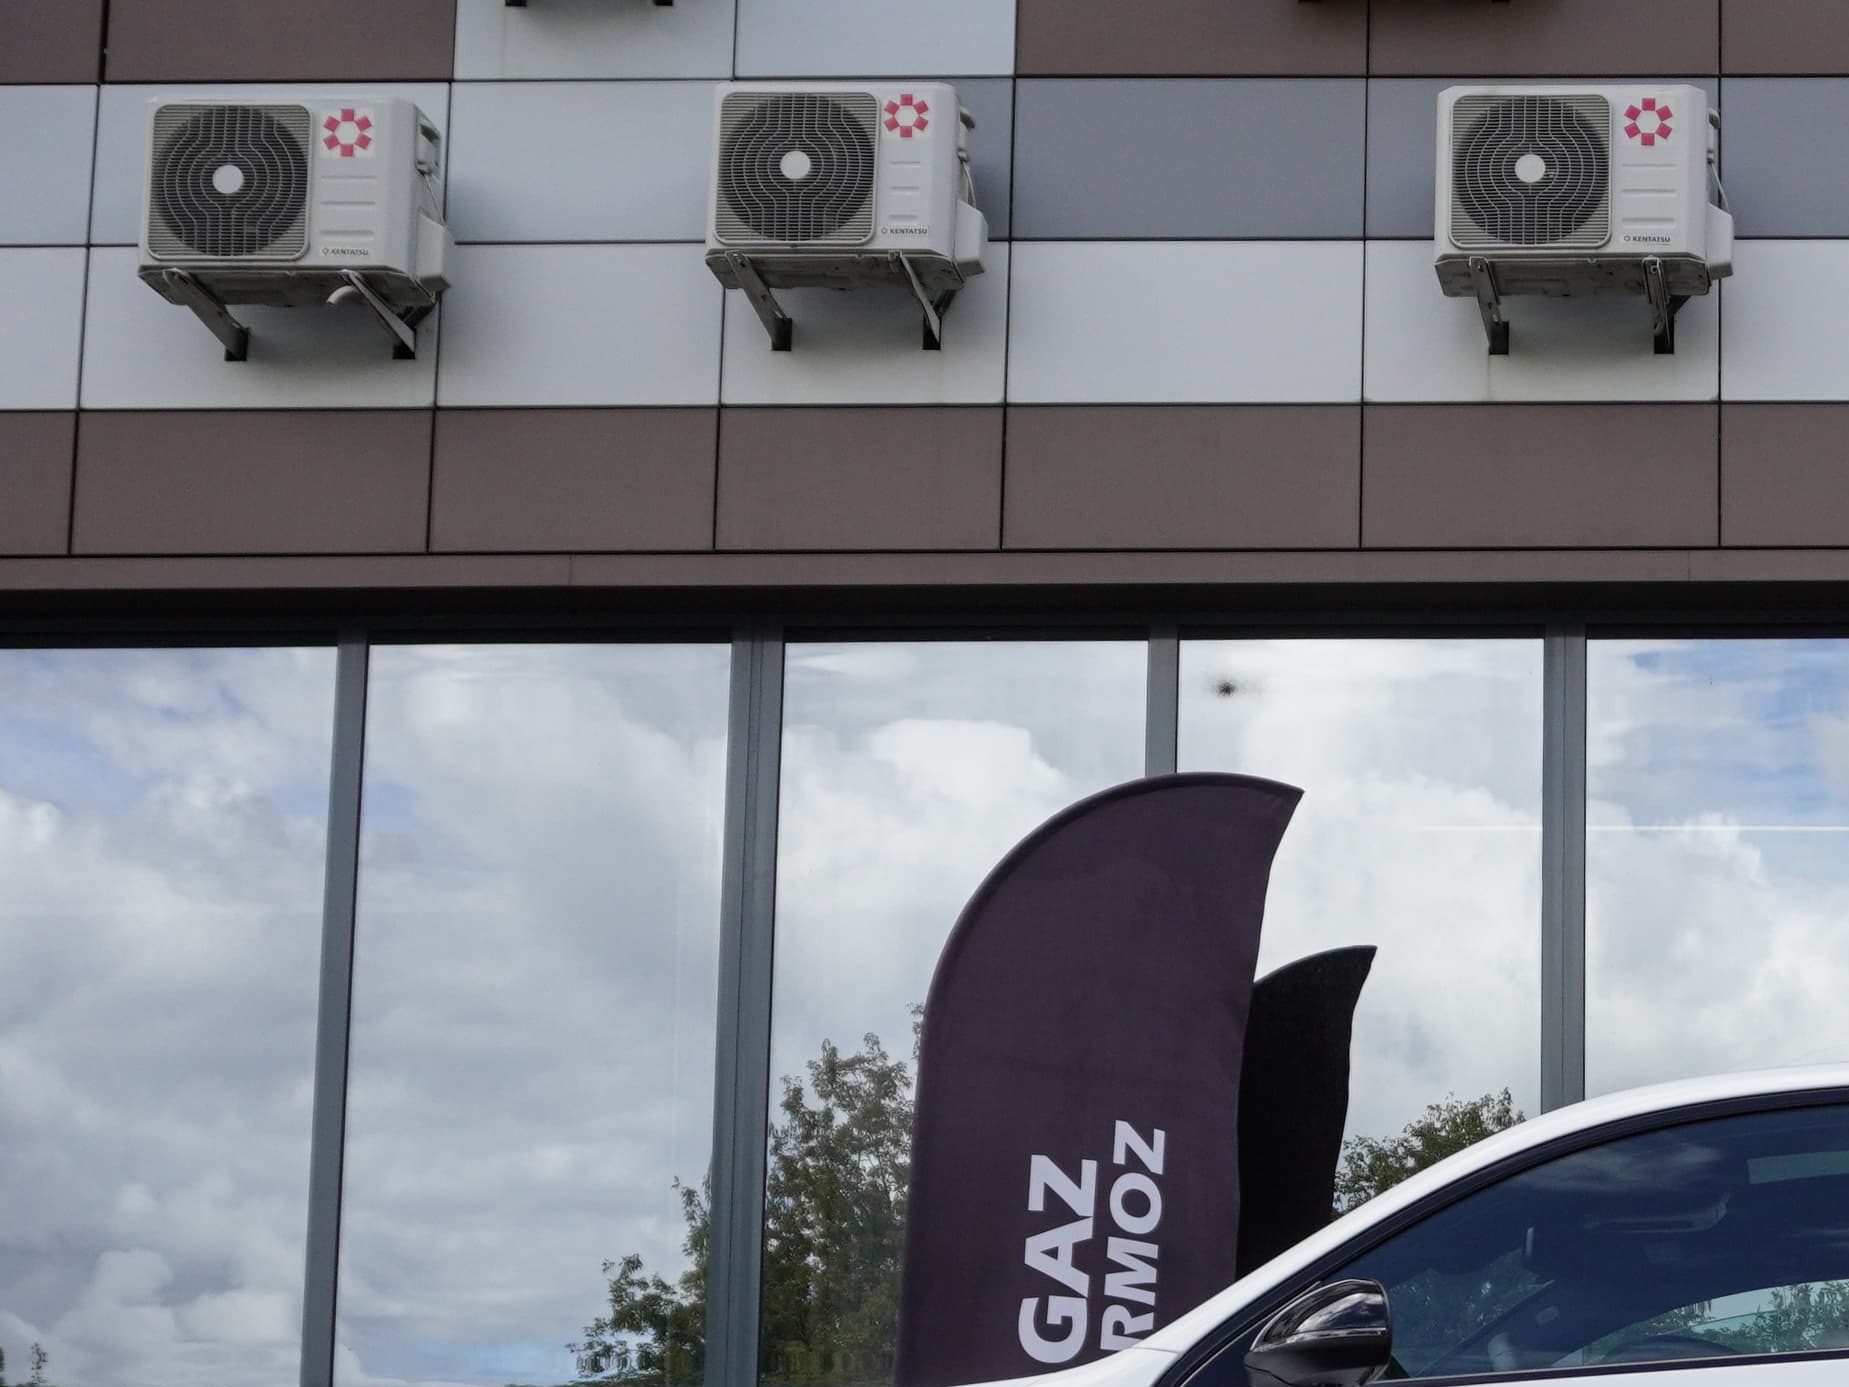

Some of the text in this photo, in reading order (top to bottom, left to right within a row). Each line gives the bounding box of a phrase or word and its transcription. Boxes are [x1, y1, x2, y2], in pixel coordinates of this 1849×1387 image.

[1632, 235, 1670, 243] KENTATSU
[331, 248, 369, 256] KENTATSU
[1018, 1154, 1098, 1364] GAZ
